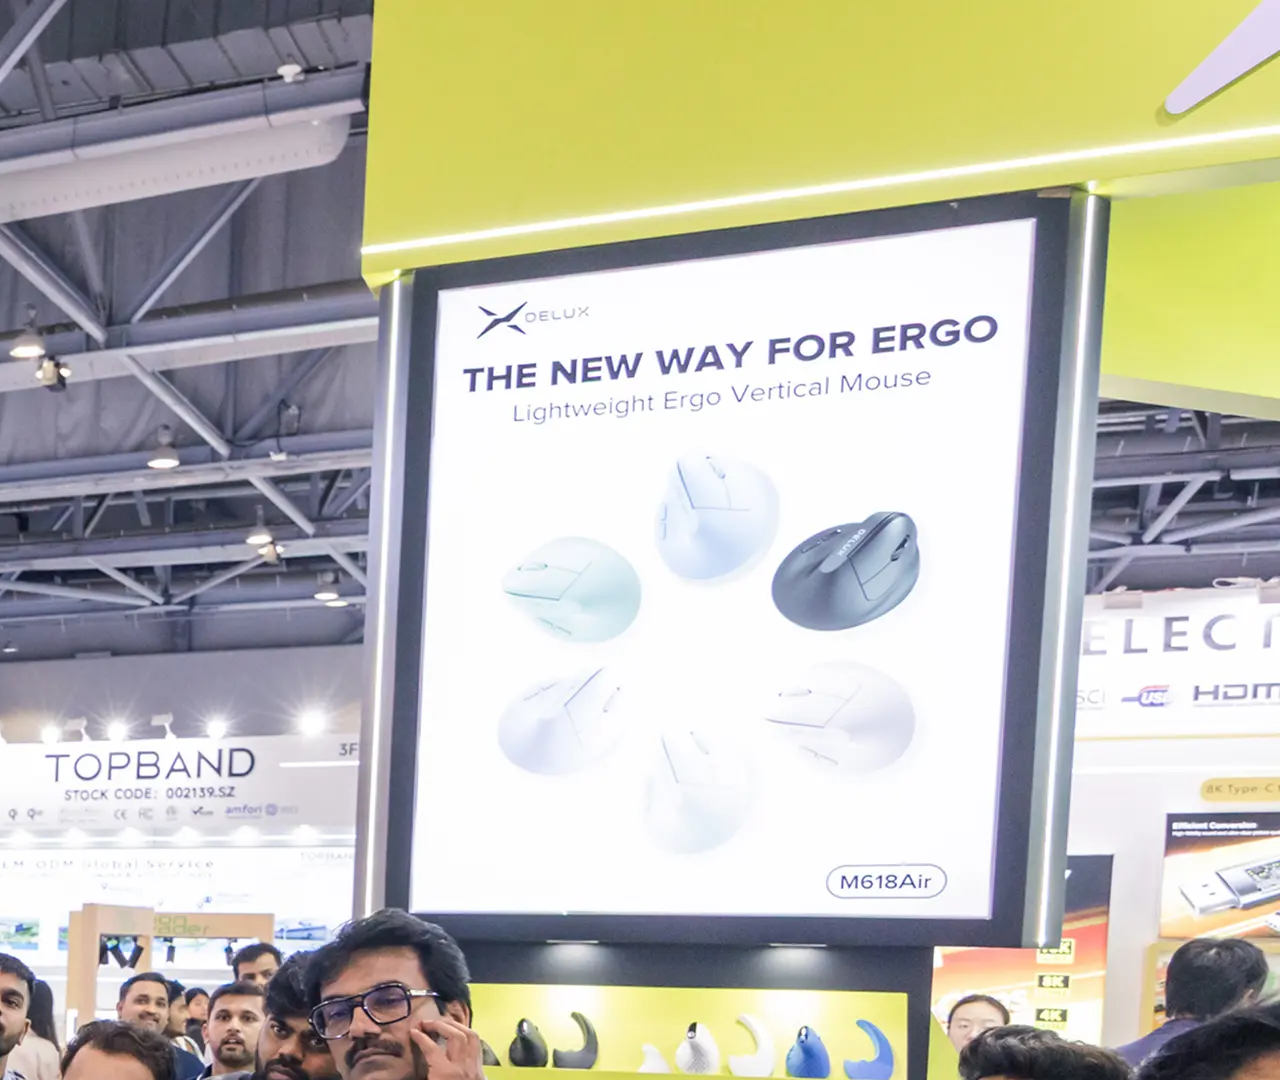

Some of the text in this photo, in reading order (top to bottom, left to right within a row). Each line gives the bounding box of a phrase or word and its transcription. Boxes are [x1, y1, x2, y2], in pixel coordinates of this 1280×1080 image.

[525, 307, 589, 323] DELUX
[463, 315, 998, 392] THE NEW WAY FOR ERGO
[514, 370, 931, 424] Lightweight Ergo Vertical Mouse
[45, 748, 255, 782] TOPBAND
[65, 786, 236, 801] STOCK CODE: 002139.SZ
[841, 874, 931, 889] M618Air
